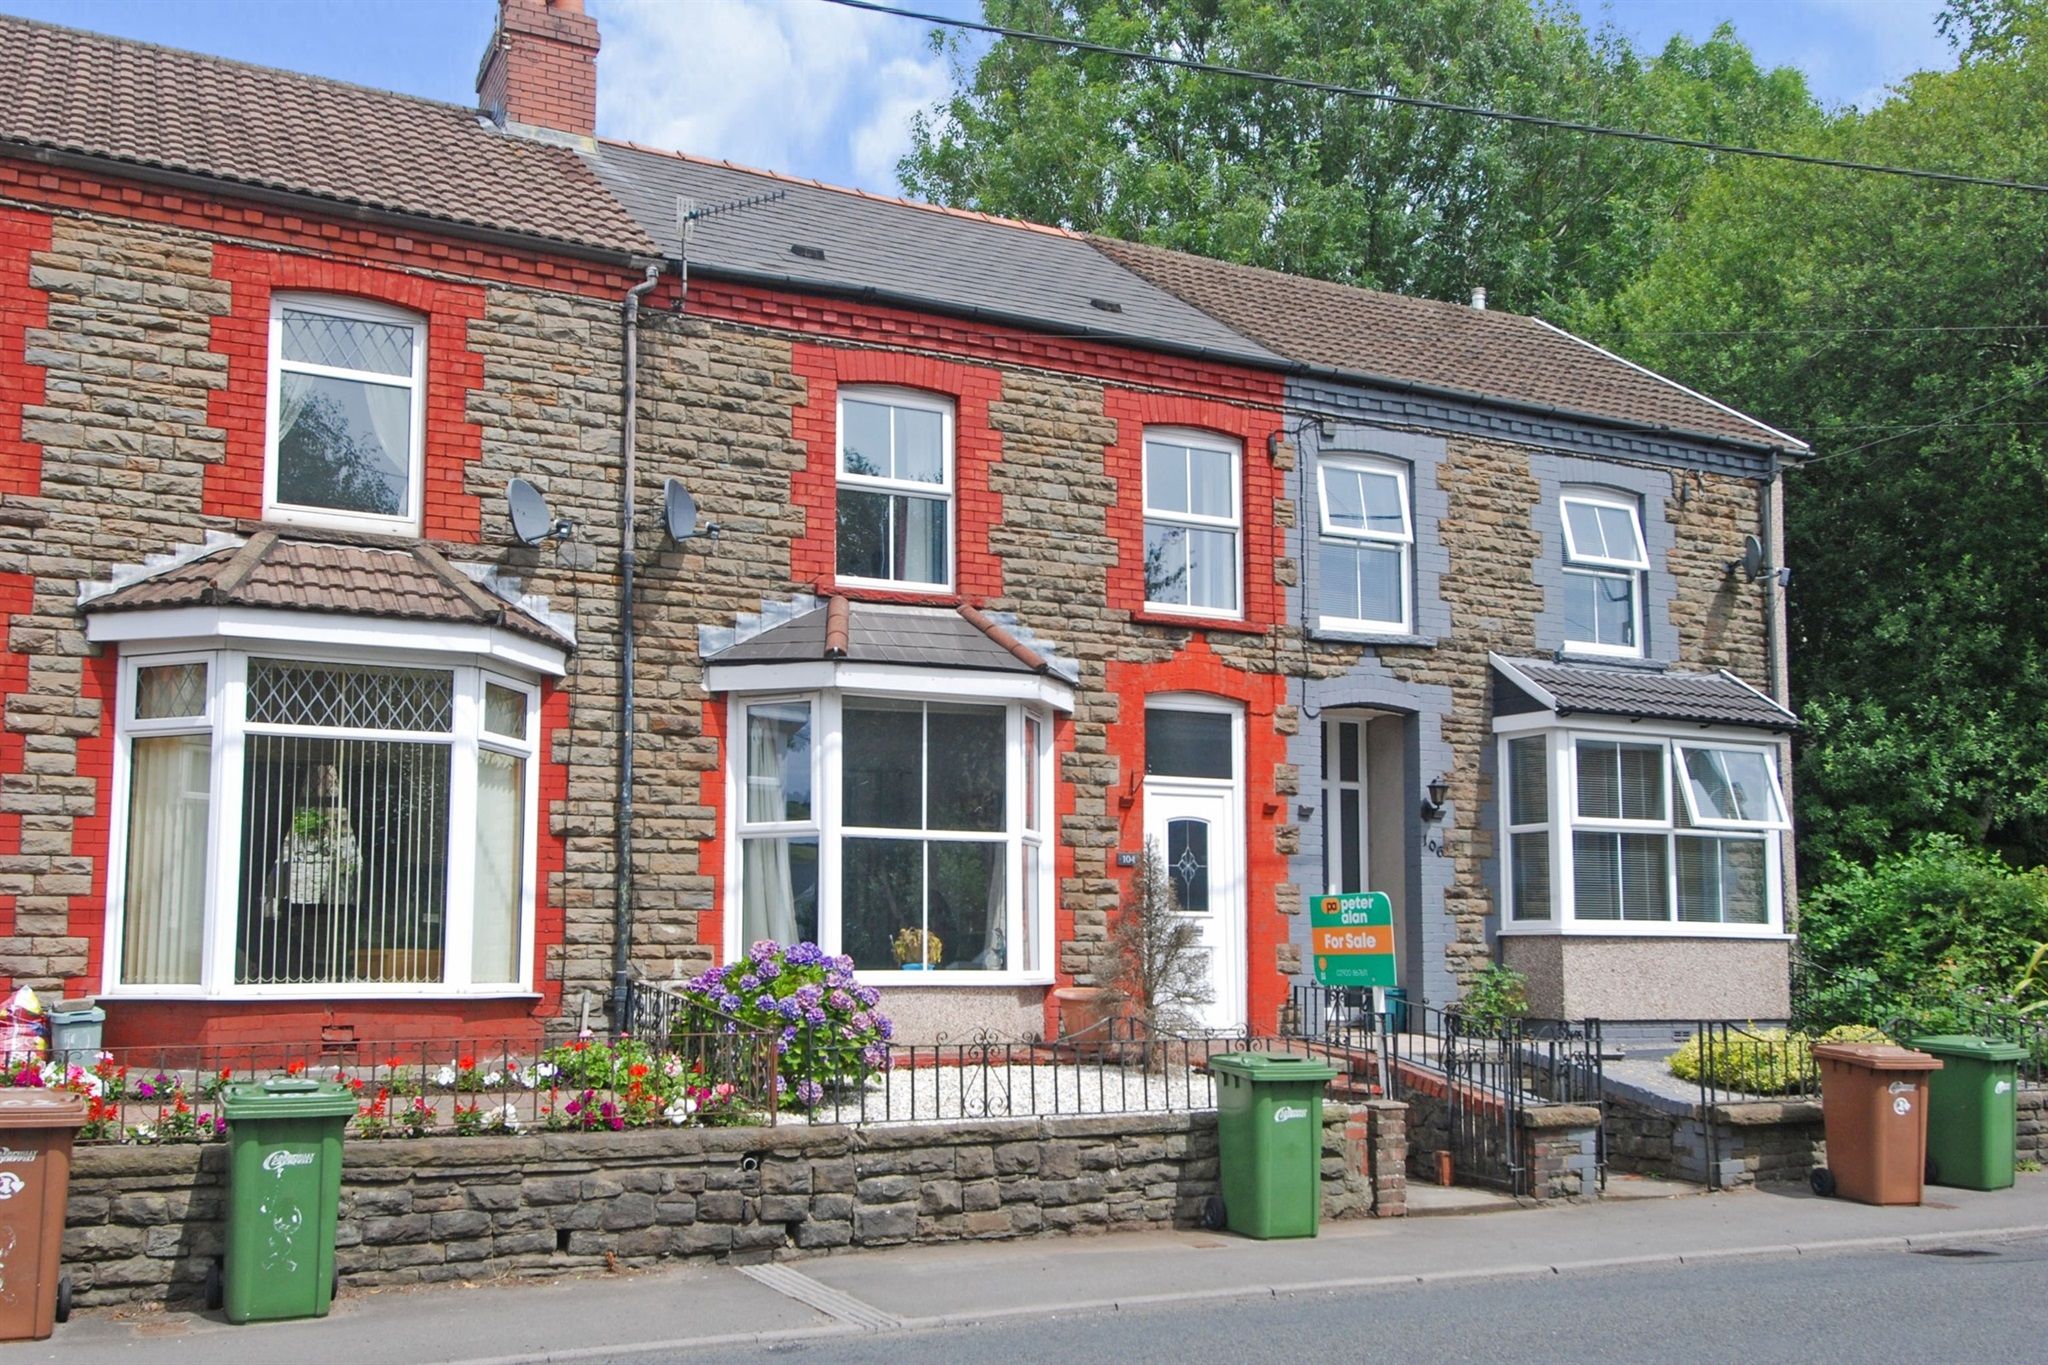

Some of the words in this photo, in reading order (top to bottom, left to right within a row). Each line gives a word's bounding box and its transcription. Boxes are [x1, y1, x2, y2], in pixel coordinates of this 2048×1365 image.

[1423, 833, 1443, 858] 106
[1122, 855, 1136, 864] 104
[1341, 896, 1374, 913] peter
[1341, 910, 1368, 924] alan
[1324, 933, 1344, 949] For
[1345, 932, 1377, 949] Sale
